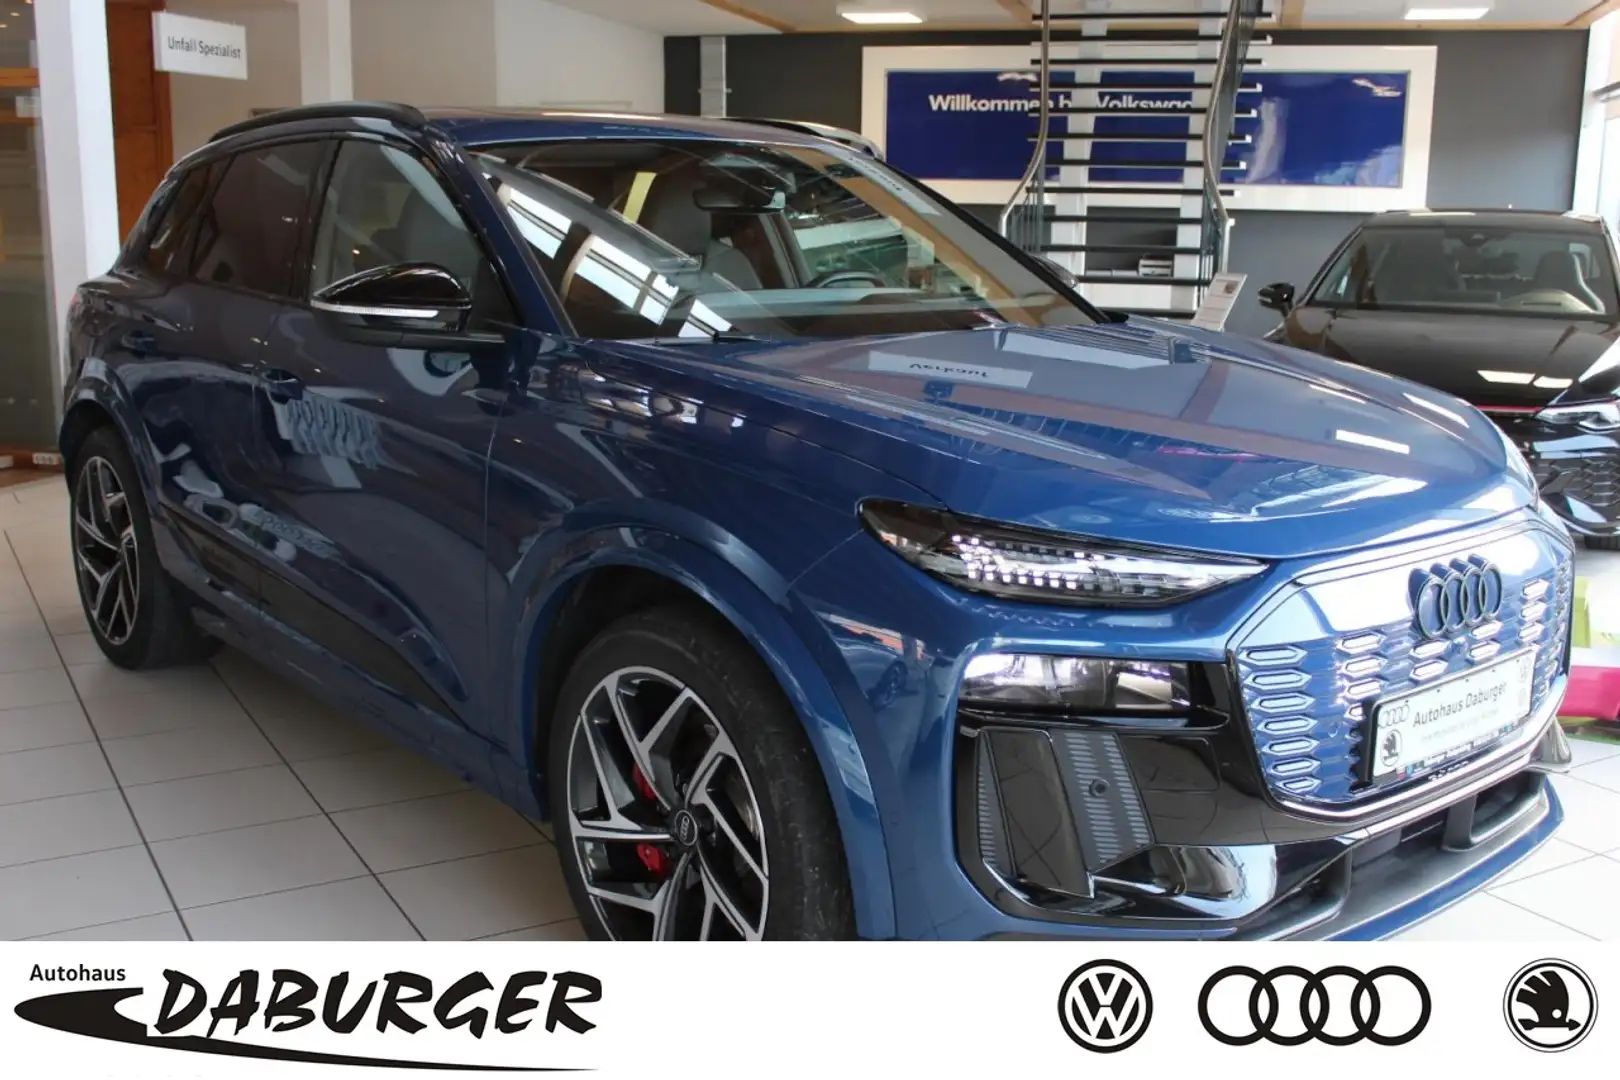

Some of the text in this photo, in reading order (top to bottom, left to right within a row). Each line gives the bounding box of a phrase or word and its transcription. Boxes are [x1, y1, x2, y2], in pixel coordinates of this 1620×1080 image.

[167, 35, 241, 59] Unfall Spezialist
[1412, 699, 1463, 728] Autohaus
[1465, 681, 1507, 709] Daburger
